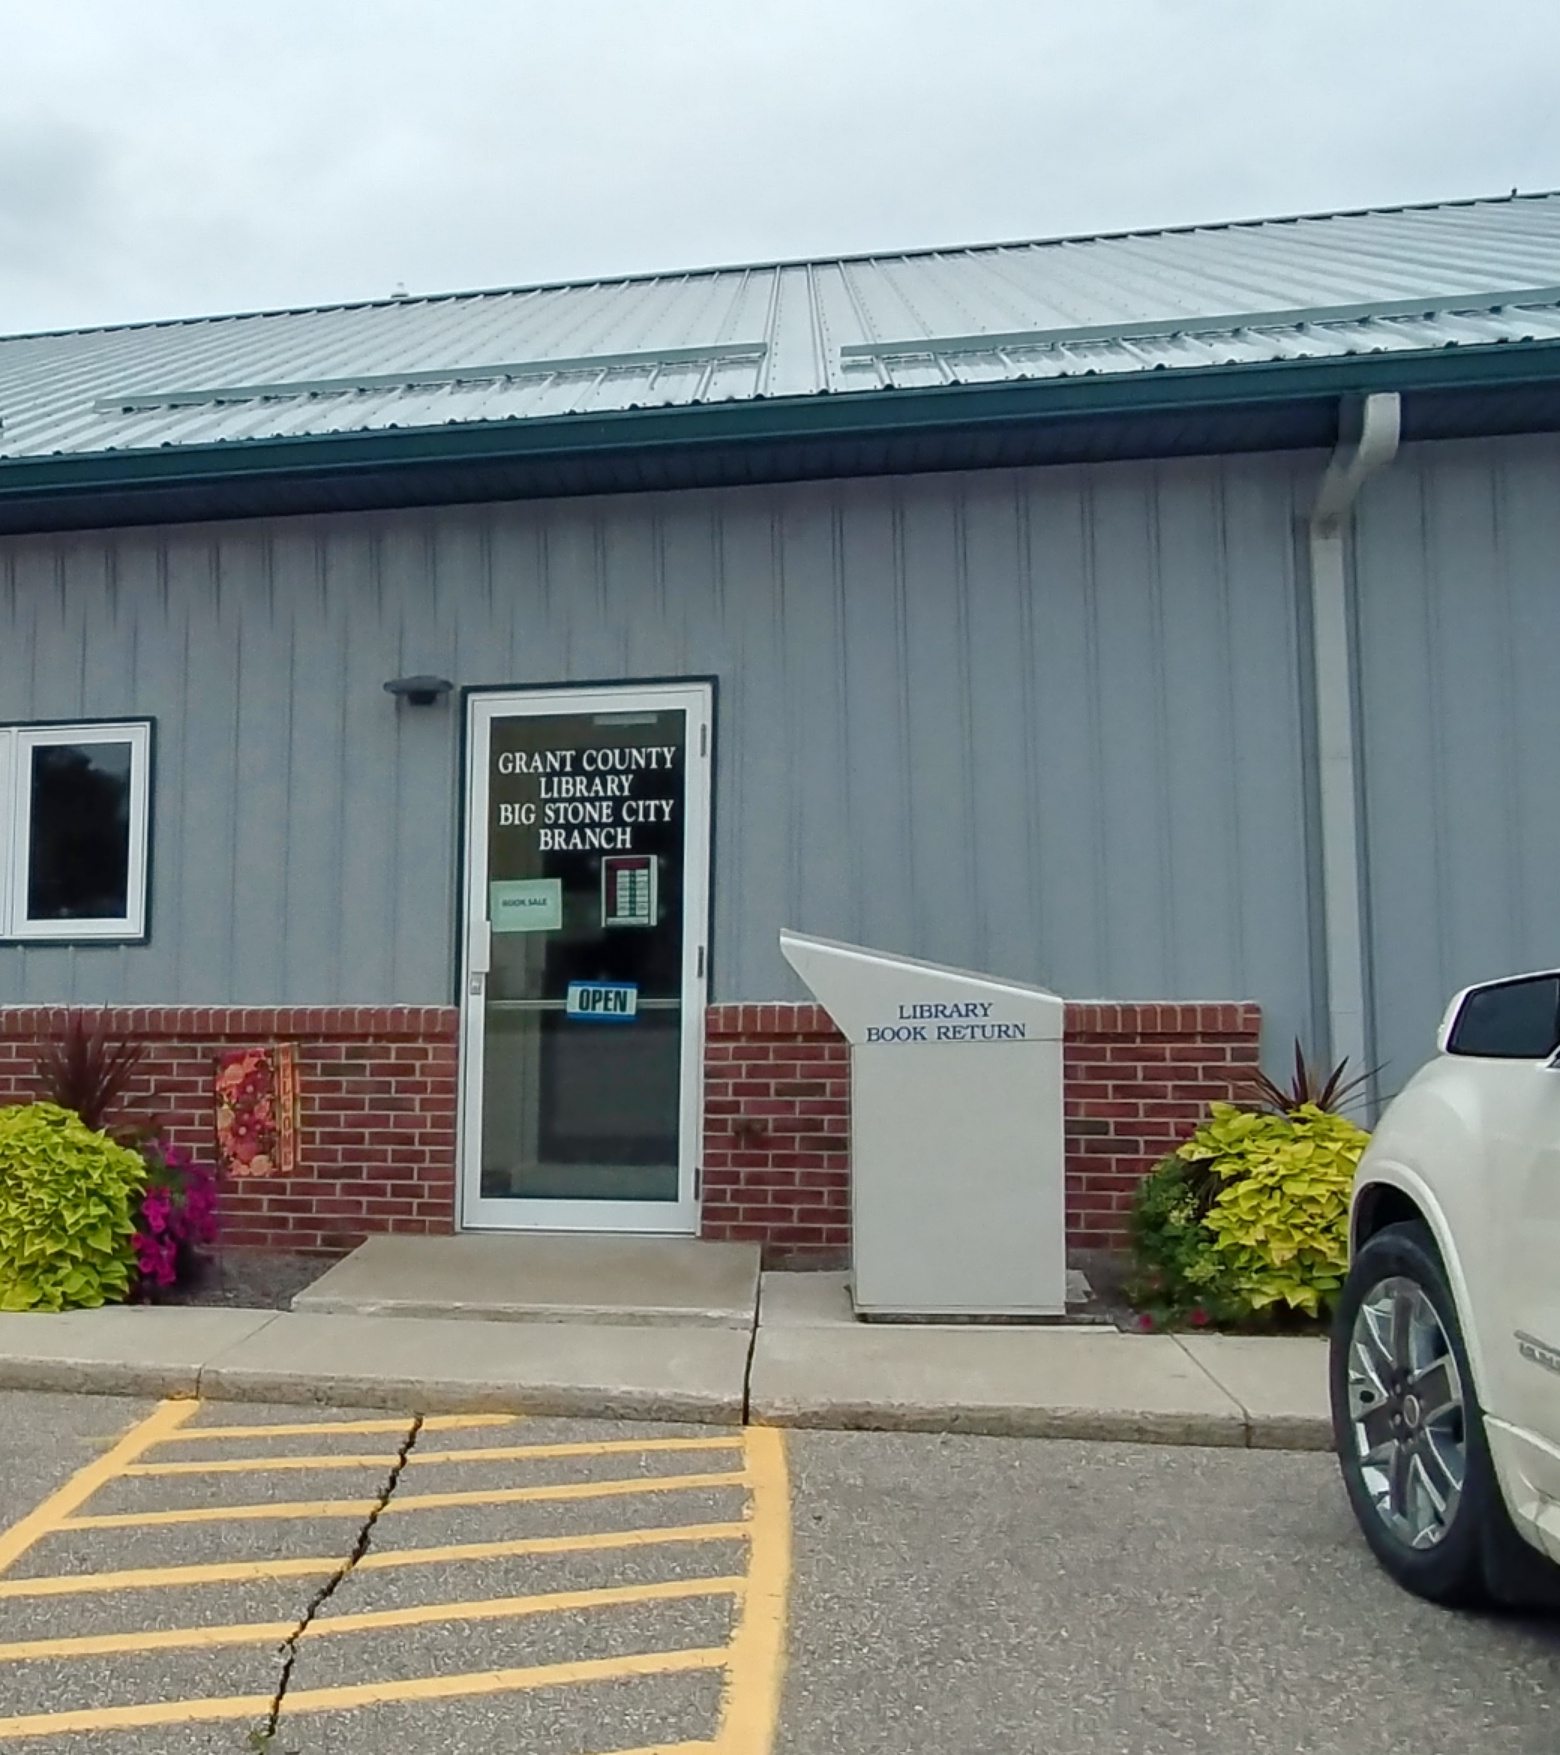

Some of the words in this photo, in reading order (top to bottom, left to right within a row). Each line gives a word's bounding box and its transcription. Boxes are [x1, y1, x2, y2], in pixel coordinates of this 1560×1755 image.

[498, 750, 576, 774] GRANT
[582, 746, 676, 771] COUNTY
[539, 774, 634, 799] LIBRARY
[499, 803, 536, 826] BIG
[544, 801, 614, 824] STONE
[622, 799, 675, 822] CITY
[539, 827, 633, 850] BRANCH
[528, 897, 547, 906] SALE
[578, 988, 628, 1013] OPEN
[898, 1002, 993, 1020] LIBRARY
[866, 1025, 928, 1042] BOOK
[936, 1023, 1026, 1040] RETURN
